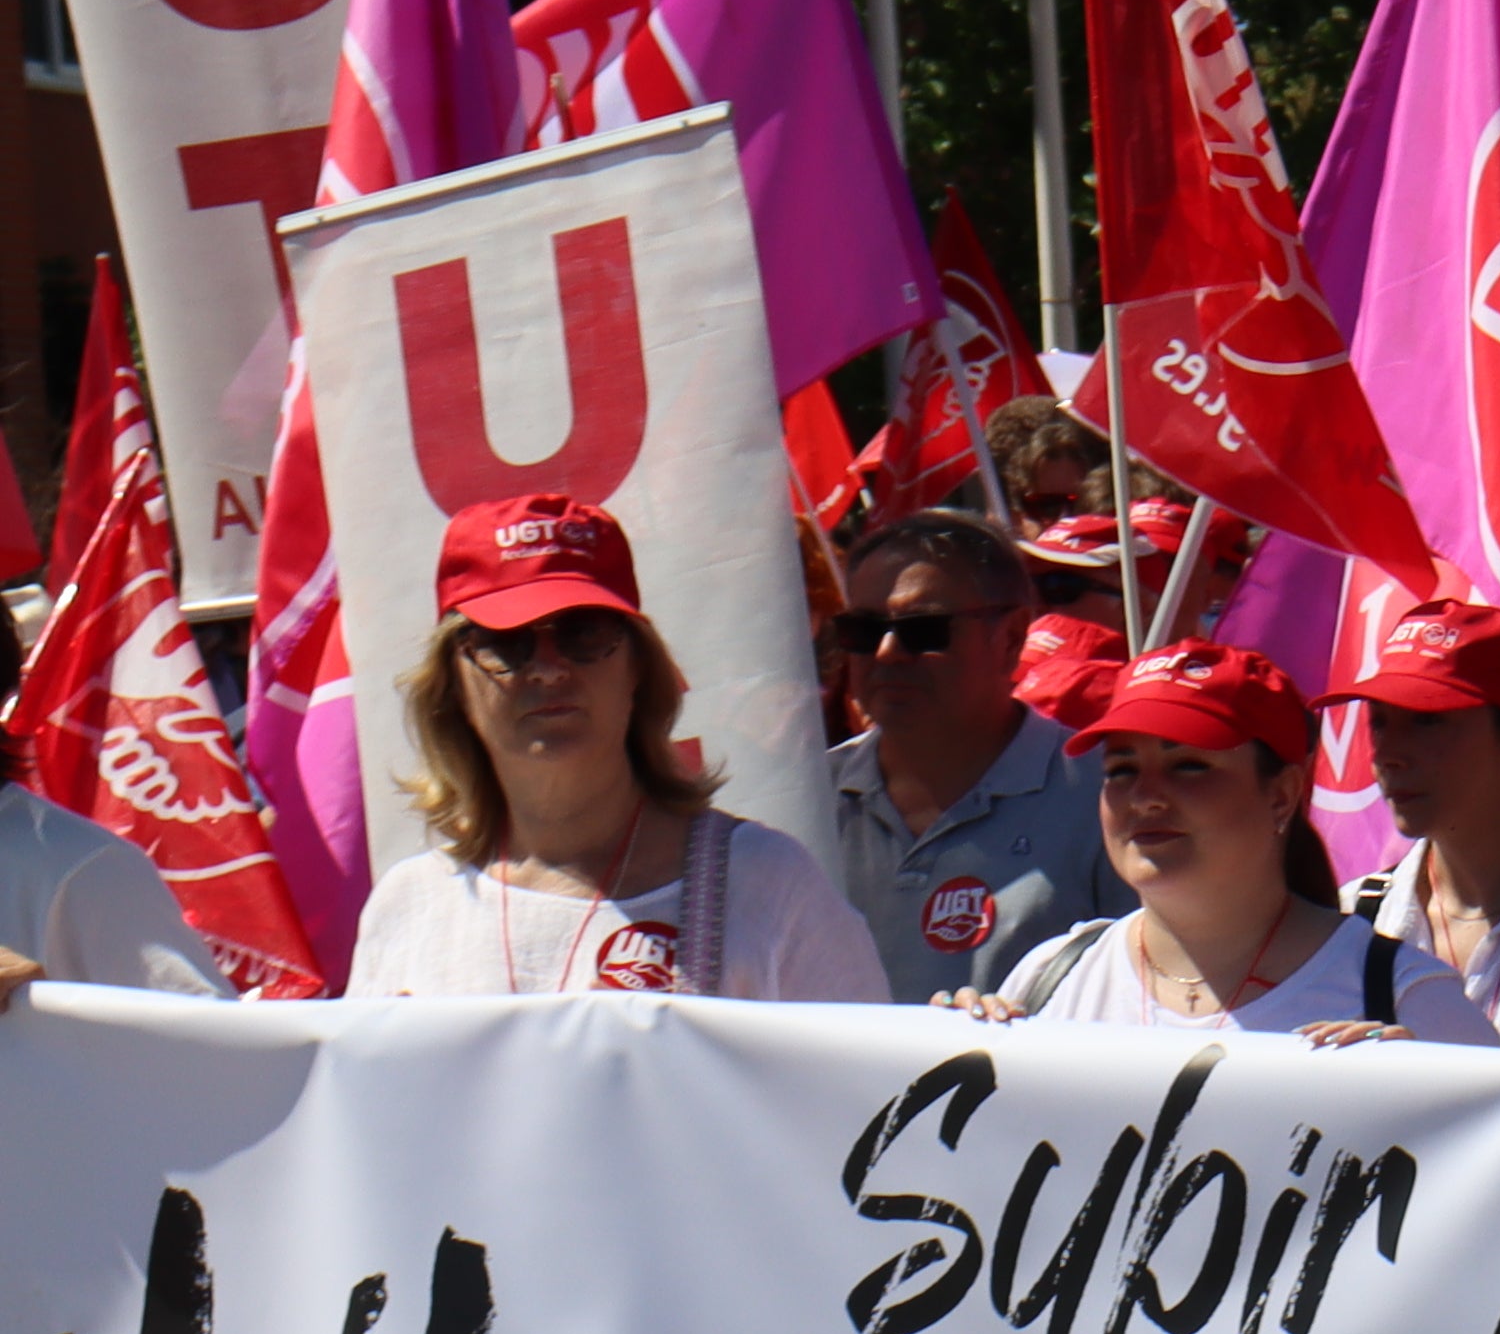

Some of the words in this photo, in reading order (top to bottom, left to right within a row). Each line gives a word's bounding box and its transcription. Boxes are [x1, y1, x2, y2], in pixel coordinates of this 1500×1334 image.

[495, 519, 557, 547] UGT
[930, 887, 986, 924] UGT
[605, 929, 677, 966] UG
